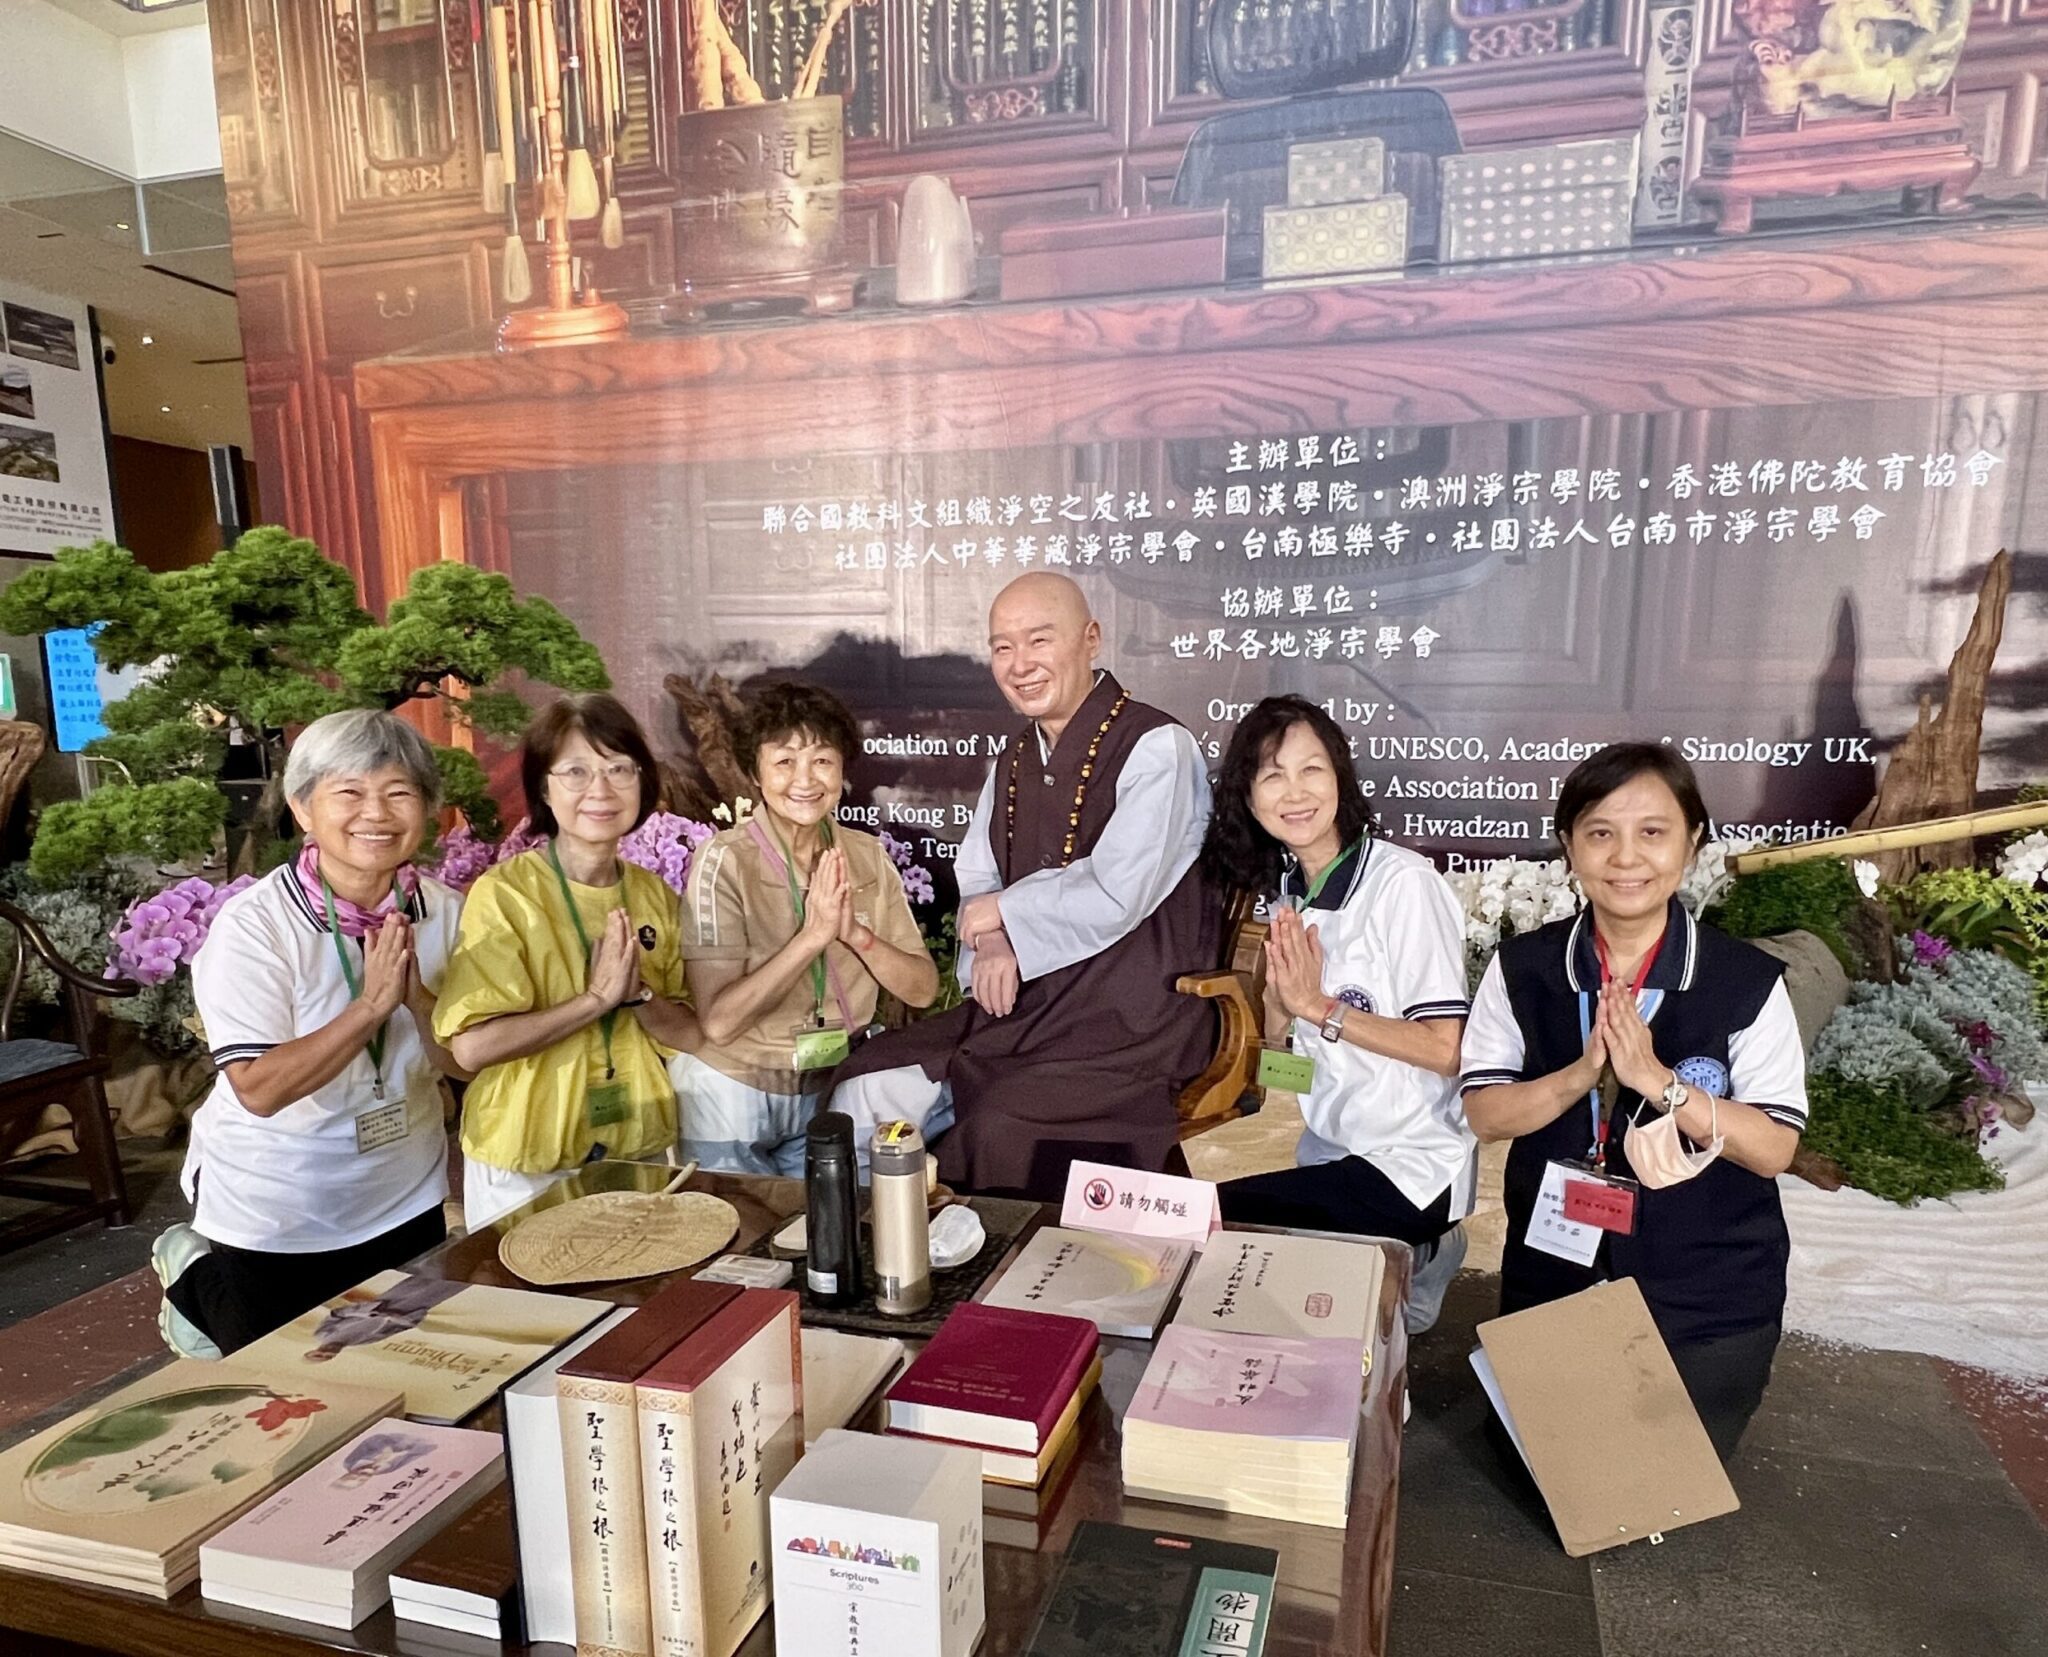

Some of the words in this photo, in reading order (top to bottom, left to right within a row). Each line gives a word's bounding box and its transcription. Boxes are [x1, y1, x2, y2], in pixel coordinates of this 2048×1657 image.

[1170, 625, 1441, 662] 世界各地淨宗學會
[863, 733, 949, 756] ociation
[956, 734, 979, 756] of
[1369, 737, 1490, 763] UNESCO,
[1681, 736, 1812, 767] Sinology
[1824, 738, 1877, 766] UK,
[1384, 775, 1538, 800] Association
[887, 803, 946, 828] Kong
[1402, 813, 1530, 839] Hwadzan
[1119, 1192, 1188, 1218] 請勿觸碰
[830, 1568, 879, 1585] Scriptures
